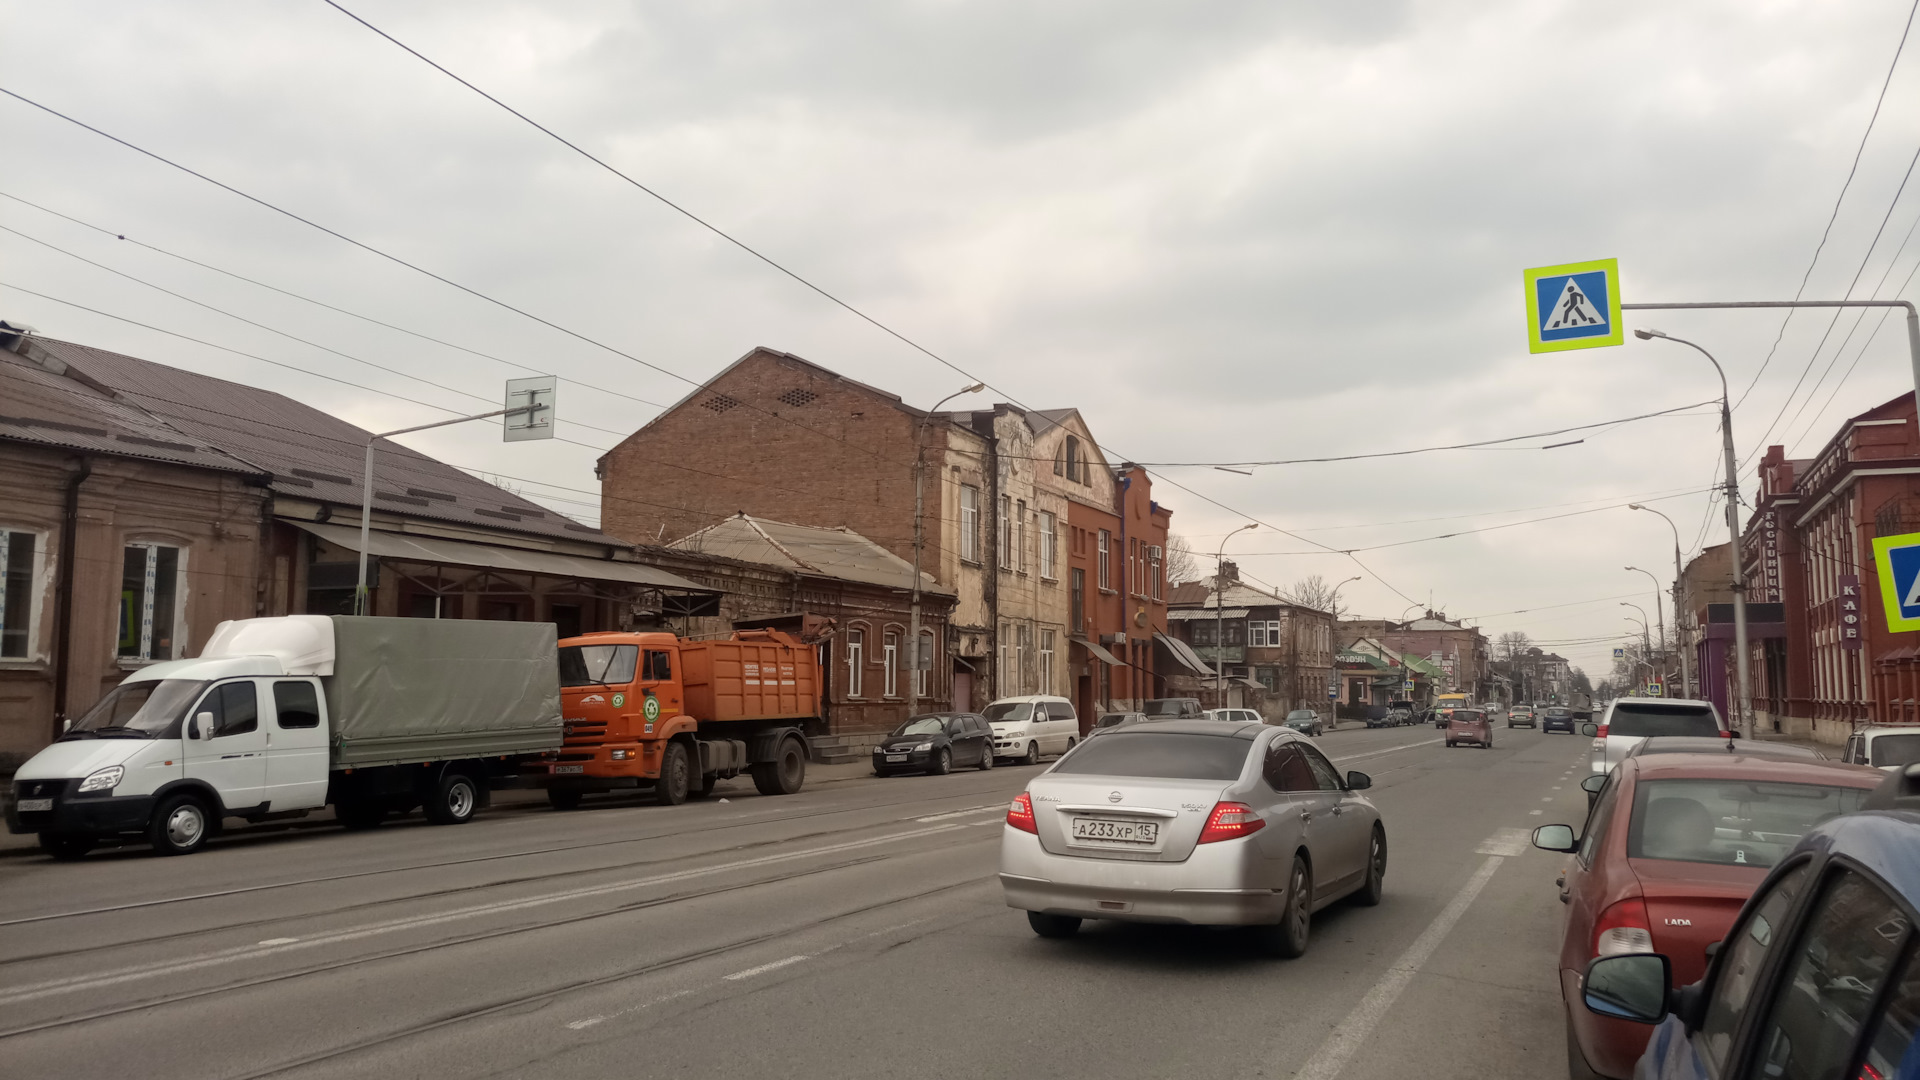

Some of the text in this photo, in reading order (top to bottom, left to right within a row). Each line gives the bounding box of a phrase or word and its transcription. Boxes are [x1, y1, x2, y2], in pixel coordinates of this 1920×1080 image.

[1843, 585, 1858, 638] КАФЕ
[1137, 825, 1151, 836] 15
[1664, 918, 1692, 926] LADA
